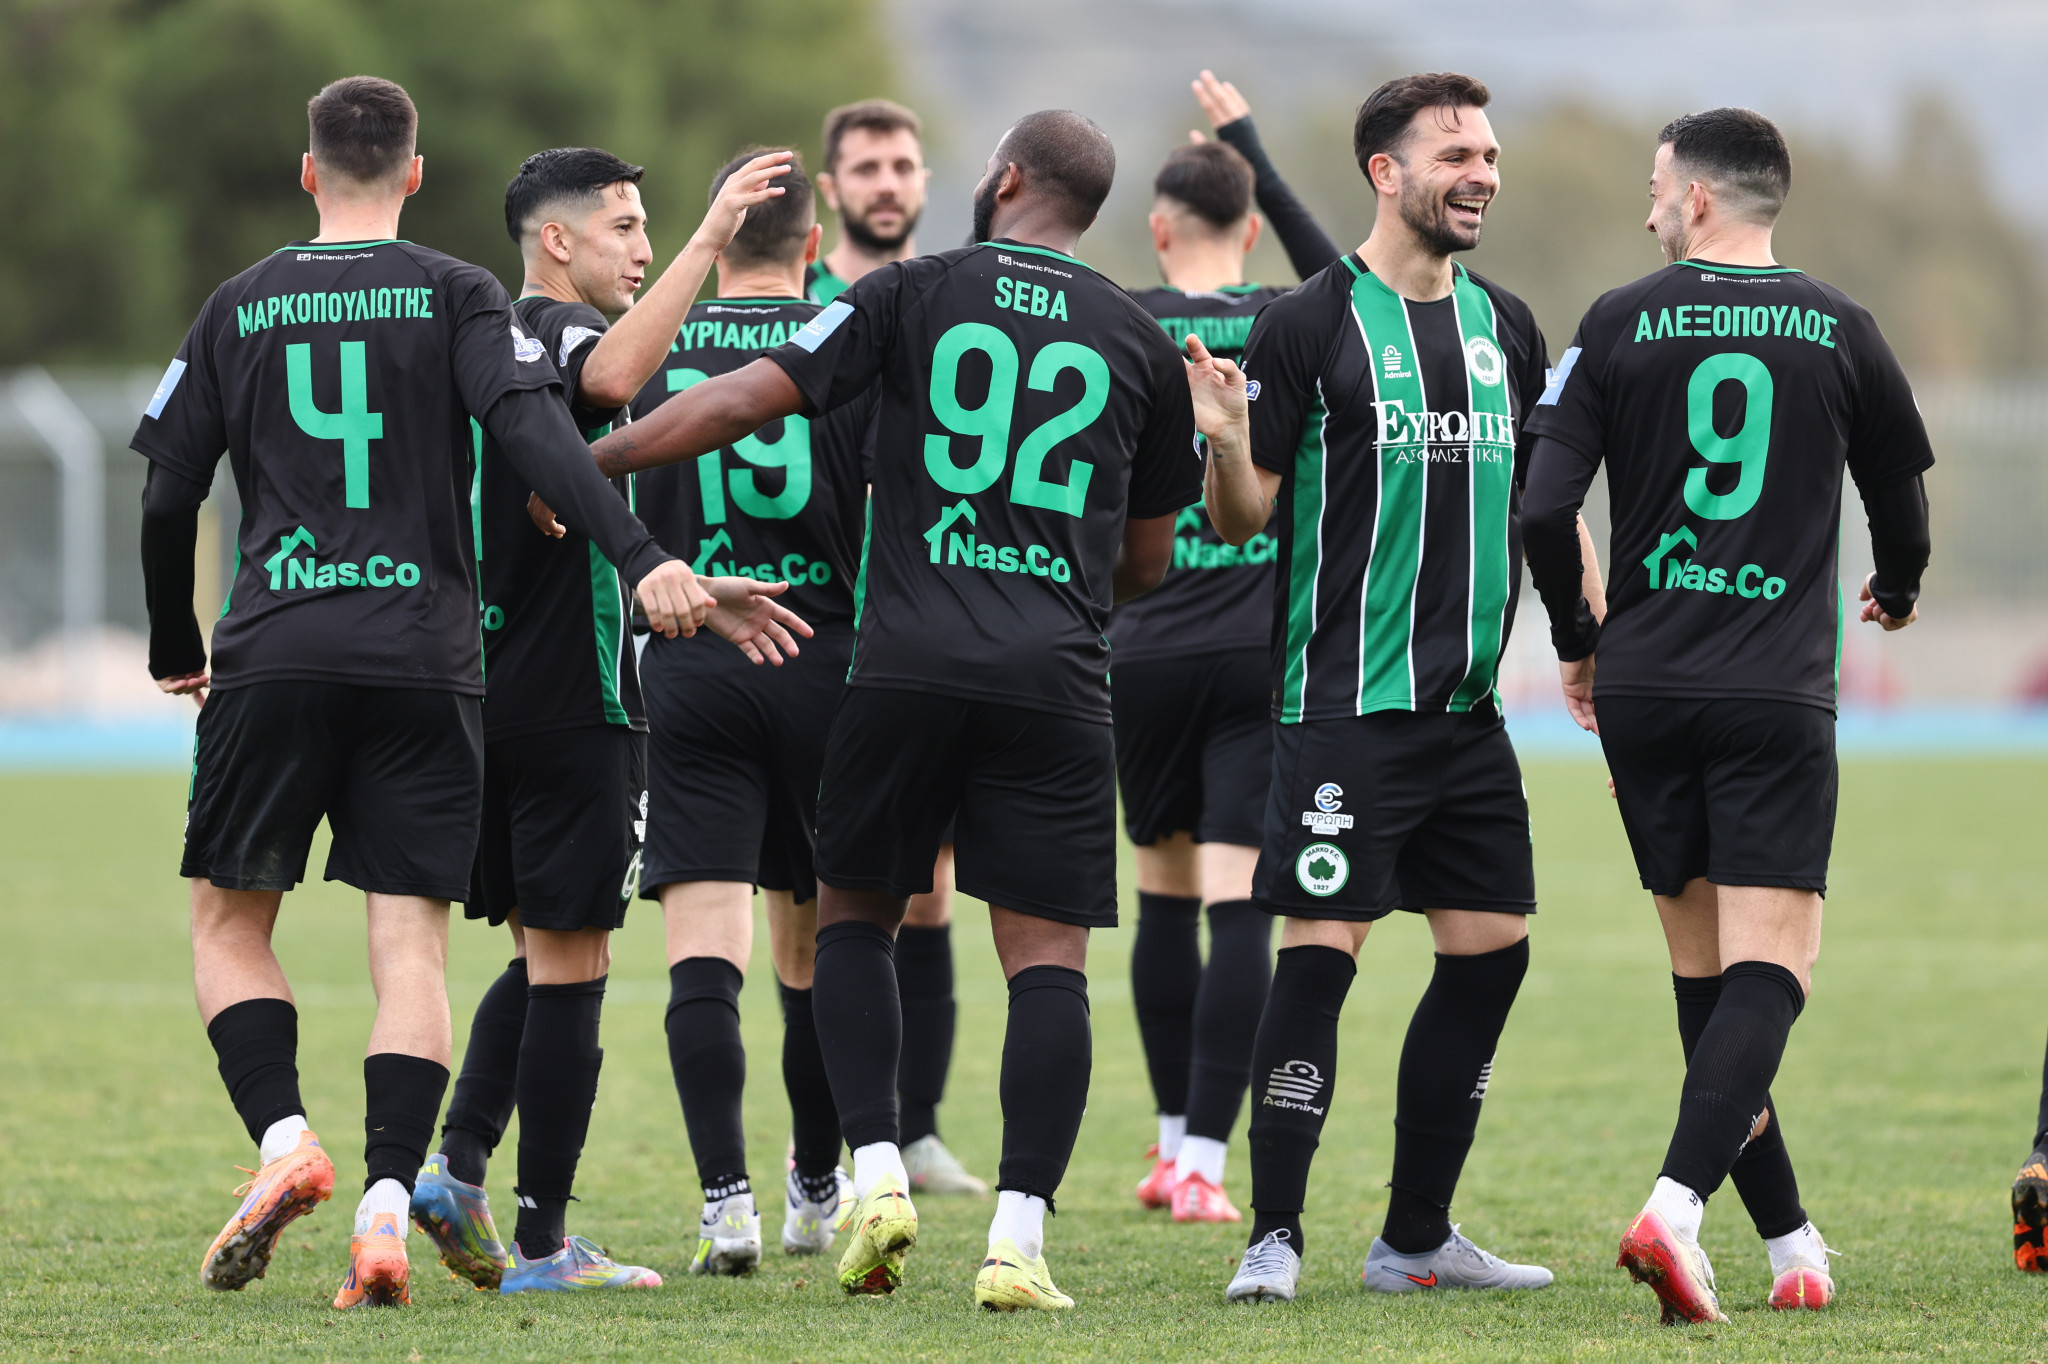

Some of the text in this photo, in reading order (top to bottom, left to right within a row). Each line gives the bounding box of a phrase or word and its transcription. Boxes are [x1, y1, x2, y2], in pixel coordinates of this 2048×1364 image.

[1013, 260, 1043, 272] Hellenic
[1043, 266, 1073, 278] Finance
[1716, 276, 1749, 284] Hellenic
[237, 287, 433, 338] ΜΑΡΚΟΠΟΥΛΙΩΤΗΣ
[994, 276, 1068, 322] SEBA
[1634, 305, 1838, 349] ΑΛΕΞΟΠΟΥΛΟΣ
[1384, 370, 1412, 379] Admiral
[285, 341, 384, 509] 4
[923, 322, 1111, 518] 92
[1683, 352, 1774, 521] 9
[1395, 448, 1502, 465] ΑΣΦΑΛΙΣΤΙΚΗ
[287, 555, 421, 590] Nas.Co
[948, 532, 1071, 583] Nas.Co
[1665, 558, 1787, 600] Nas.Co
[1303, 813, 1351, 827] ΕΥΡΩΠΗ
[1305, 846, 1340, 861] MARKO F.C.
[1263, 1095, 1324, 1116] Admiral
